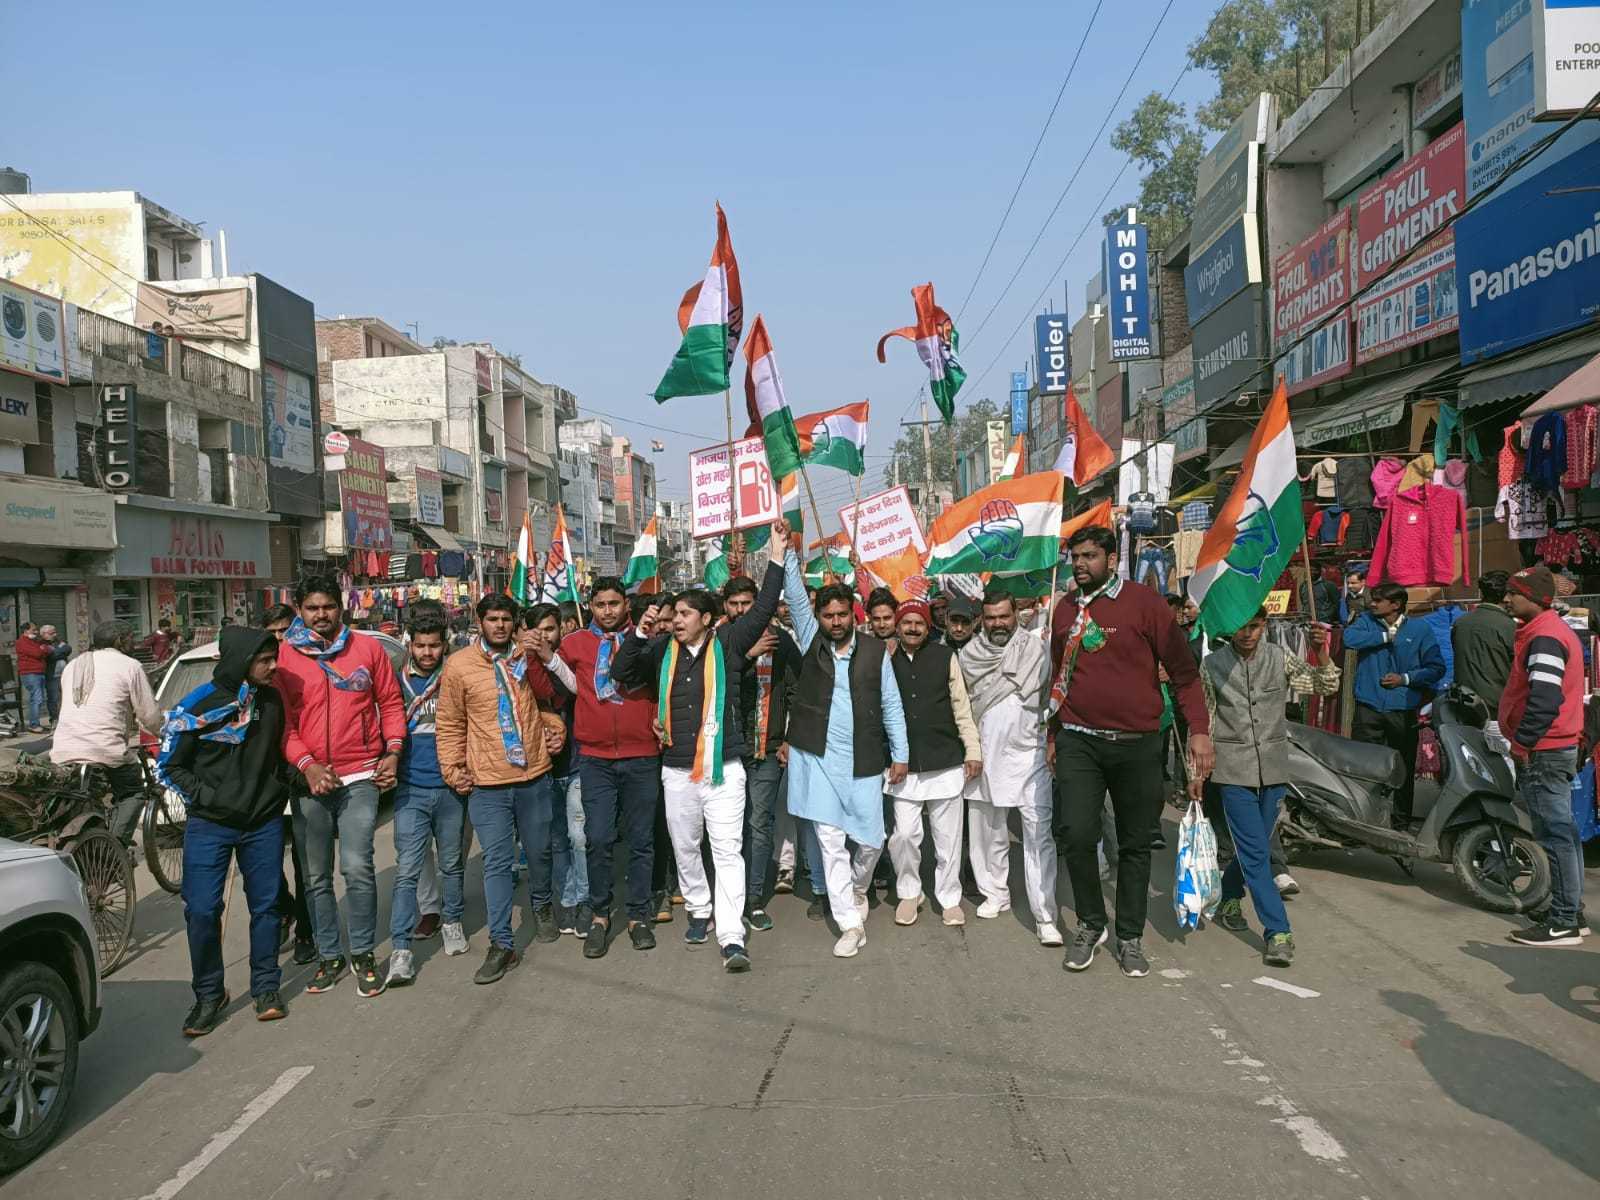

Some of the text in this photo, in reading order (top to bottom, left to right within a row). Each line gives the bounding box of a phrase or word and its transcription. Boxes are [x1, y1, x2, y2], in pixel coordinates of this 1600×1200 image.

[1383, 166, 1430, 224] PAUL
[1360, 189, 1457, 273] GARMENTS
[1117, 229, 1139, 335] MOHIT
[1197, 244, 1235, 297] Whirlpool
[1278, 262, 1308, 302] PAUL
[1277, 268, 1345, 331] GARMENTS
[1045, 320, 1066, 392] Haier
[1113, 338, 1149, 347] DIGITAL
[1113, 347, 1150, 357] STUDIO
[1199, 331, 1249, 381] SAMSUNG
[104, 386, 131, 488] HELLO
[696, 450, 727, 466] भाजपा
[342, 471, 387, 498] GARMENTS
[191, 559, 256, 576] FOOTWEAR
